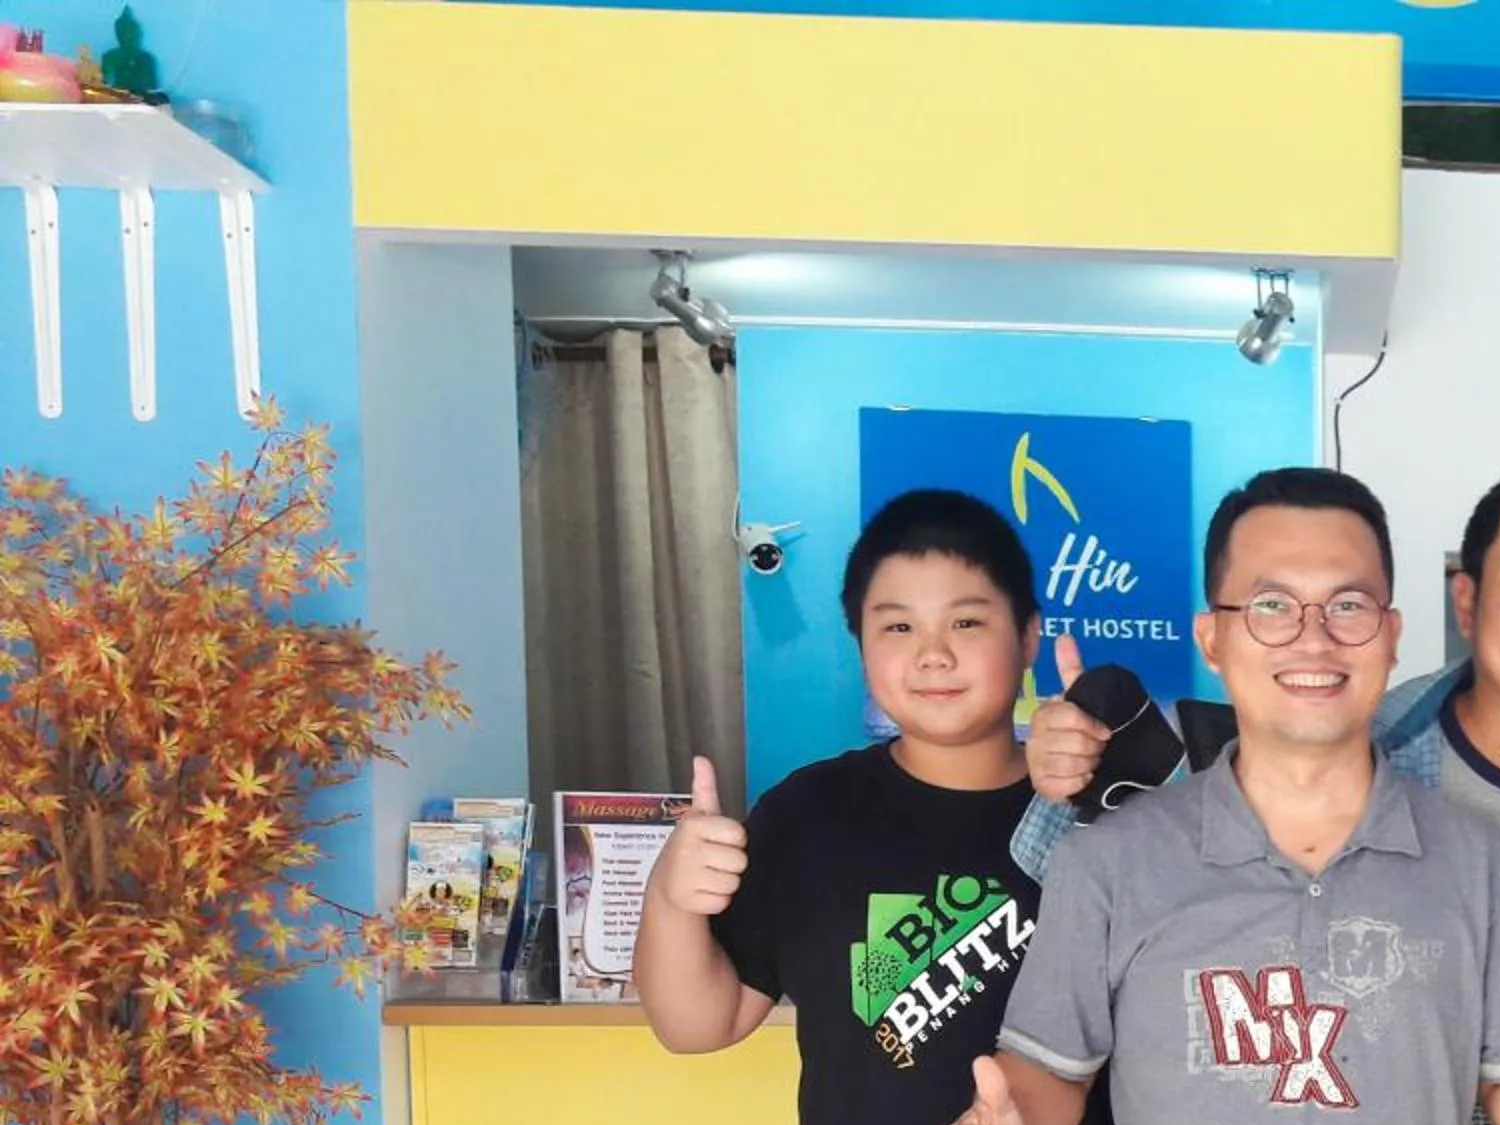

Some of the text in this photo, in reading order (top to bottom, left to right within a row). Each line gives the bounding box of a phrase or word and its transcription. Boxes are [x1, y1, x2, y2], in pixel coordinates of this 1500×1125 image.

[1045, 532, 1140, 608] Hin
[1039, 617, 1181, 641] ET HOSTEL
[885, 870, 989, 965] BIO
[883, 898, 1037, 1045] BLITZ
[875, 1023, 916, 1070] 2017
[904, 980, 986, 1055] PENANG
